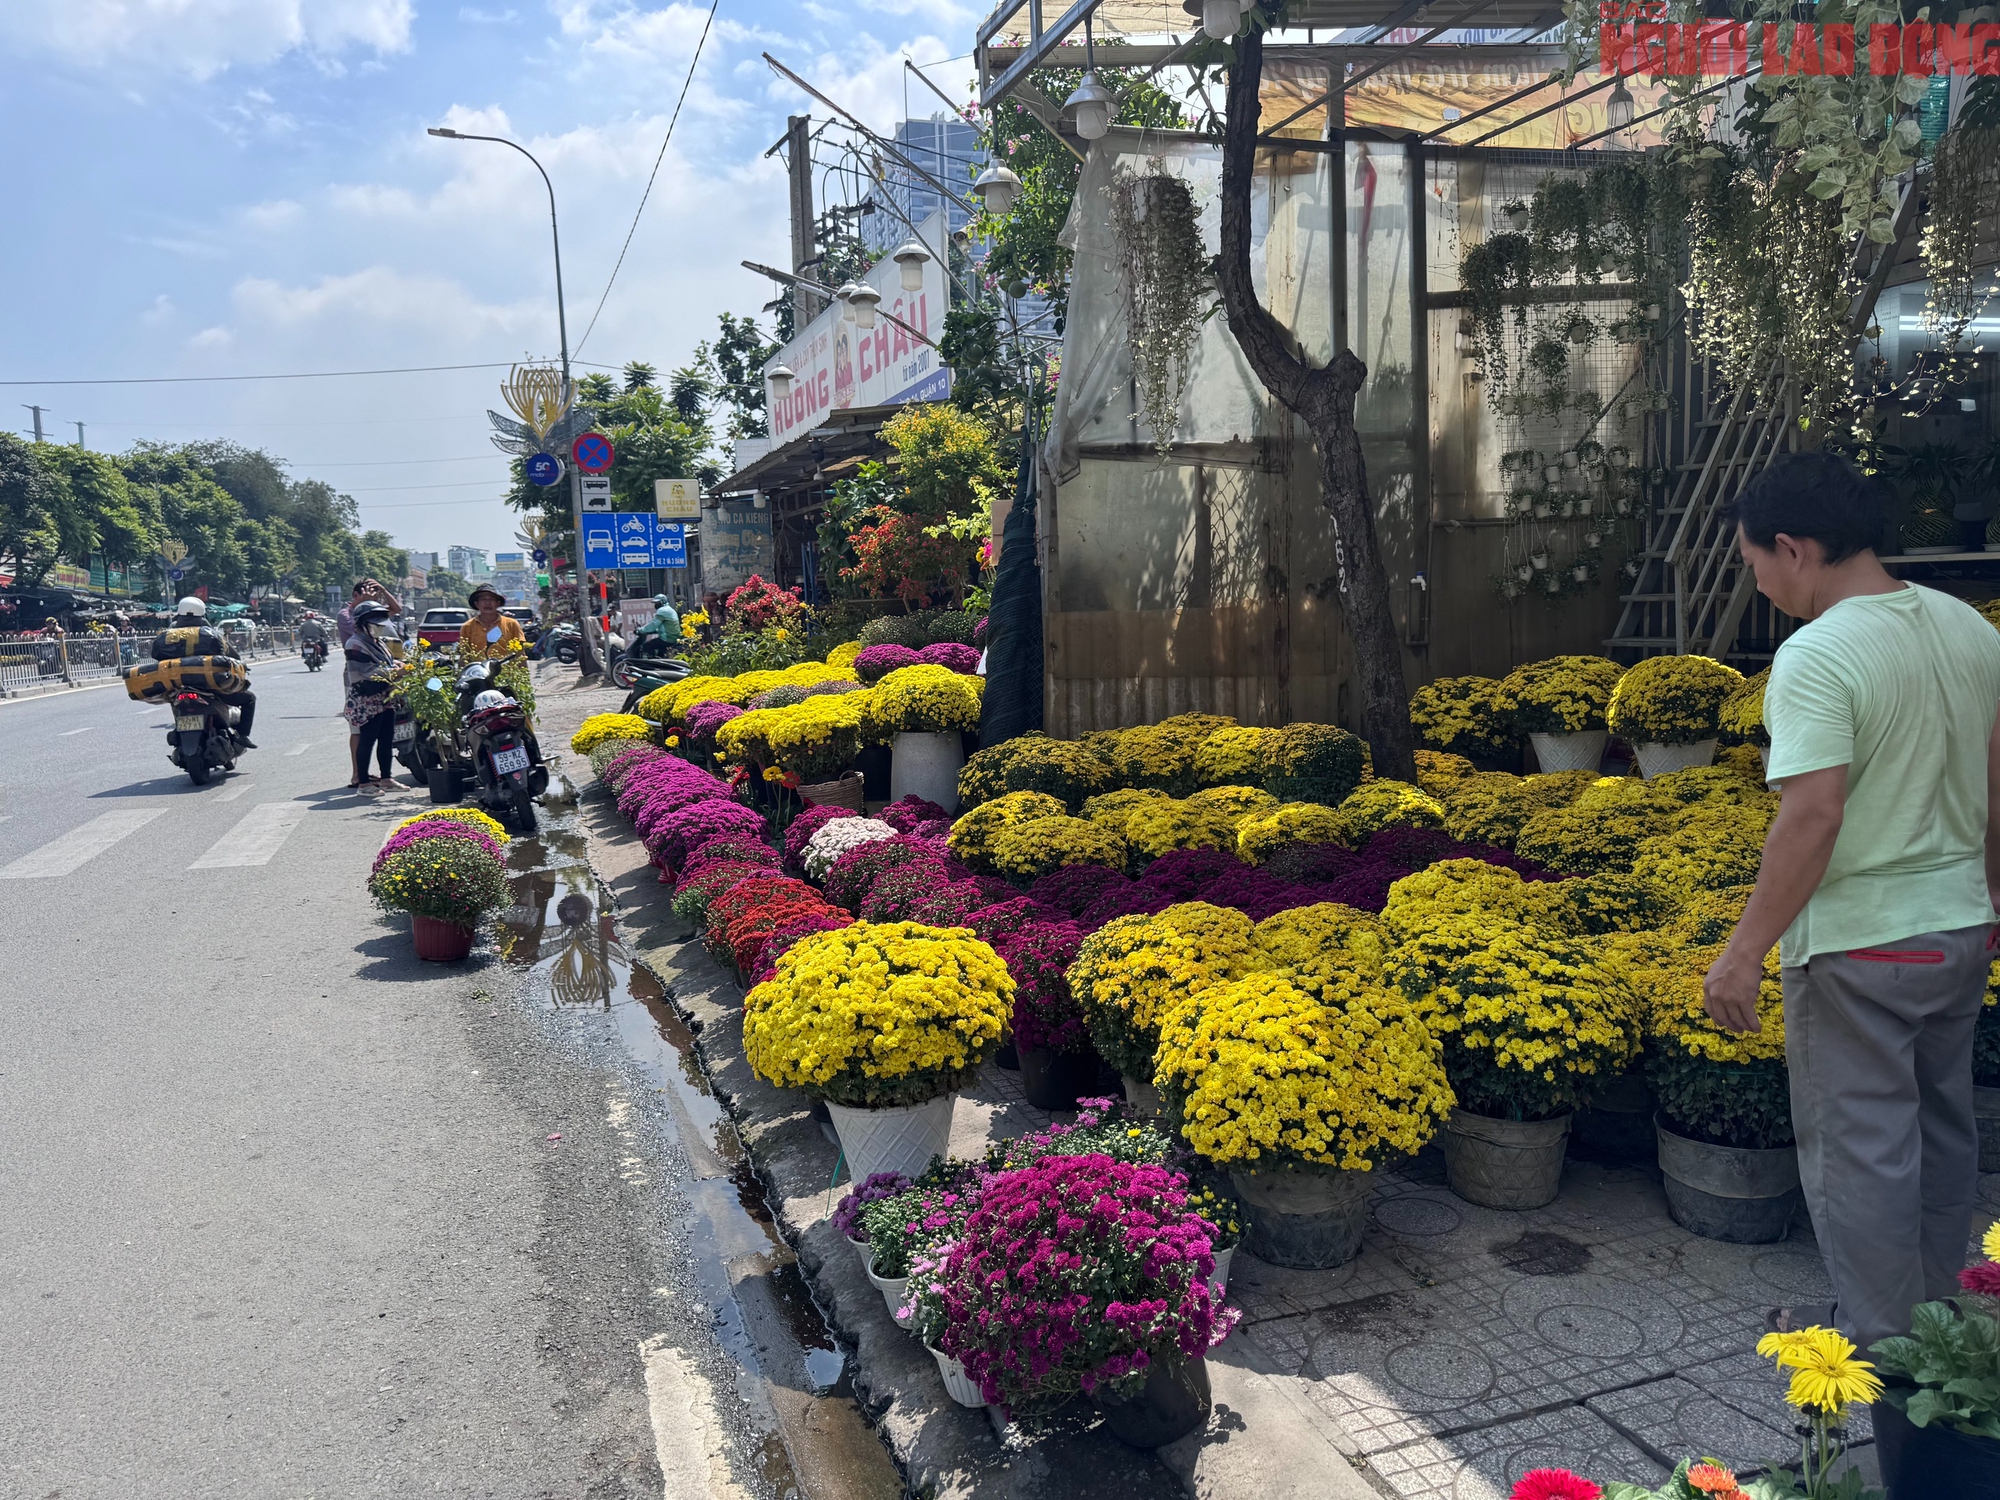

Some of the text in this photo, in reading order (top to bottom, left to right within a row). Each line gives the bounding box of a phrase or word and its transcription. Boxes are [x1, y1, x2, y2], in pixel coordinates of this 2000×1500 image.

[858, 293, 928, 384] CHÂU
[918, 348, 930, 374] 2007
[920, 382, 937, 401] QUẬN
[938, 377, 946, 391] 10
[535, 461, 551, 472] 5G
[498, 749, 522, 763] 59-M2
[499, 757, 527, 773] 659.95
